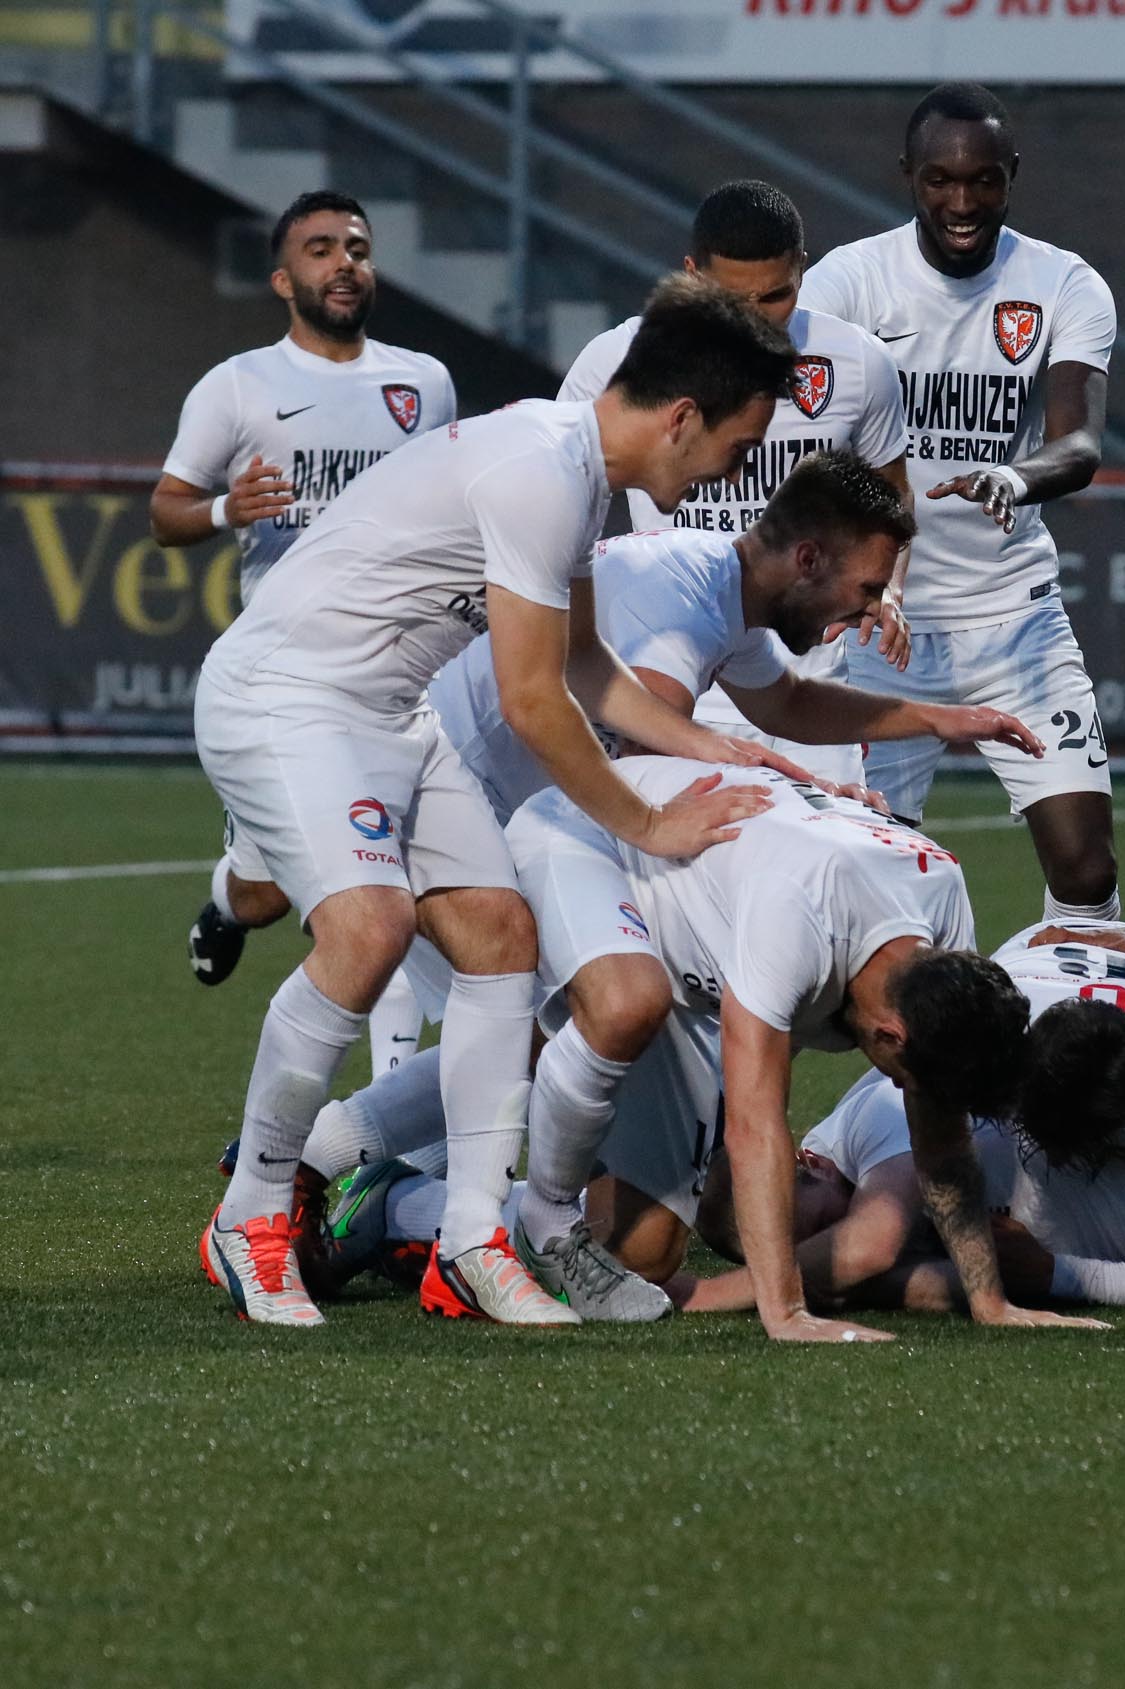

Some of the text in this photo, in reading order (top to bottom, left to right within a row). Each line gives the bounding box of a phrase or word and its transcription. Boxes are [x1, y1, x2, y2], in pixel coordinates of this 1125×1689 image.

[918, 435, 935, 460] &
[718, 508, 735, 532] &
[1051, 709, 1107, 752] 24
